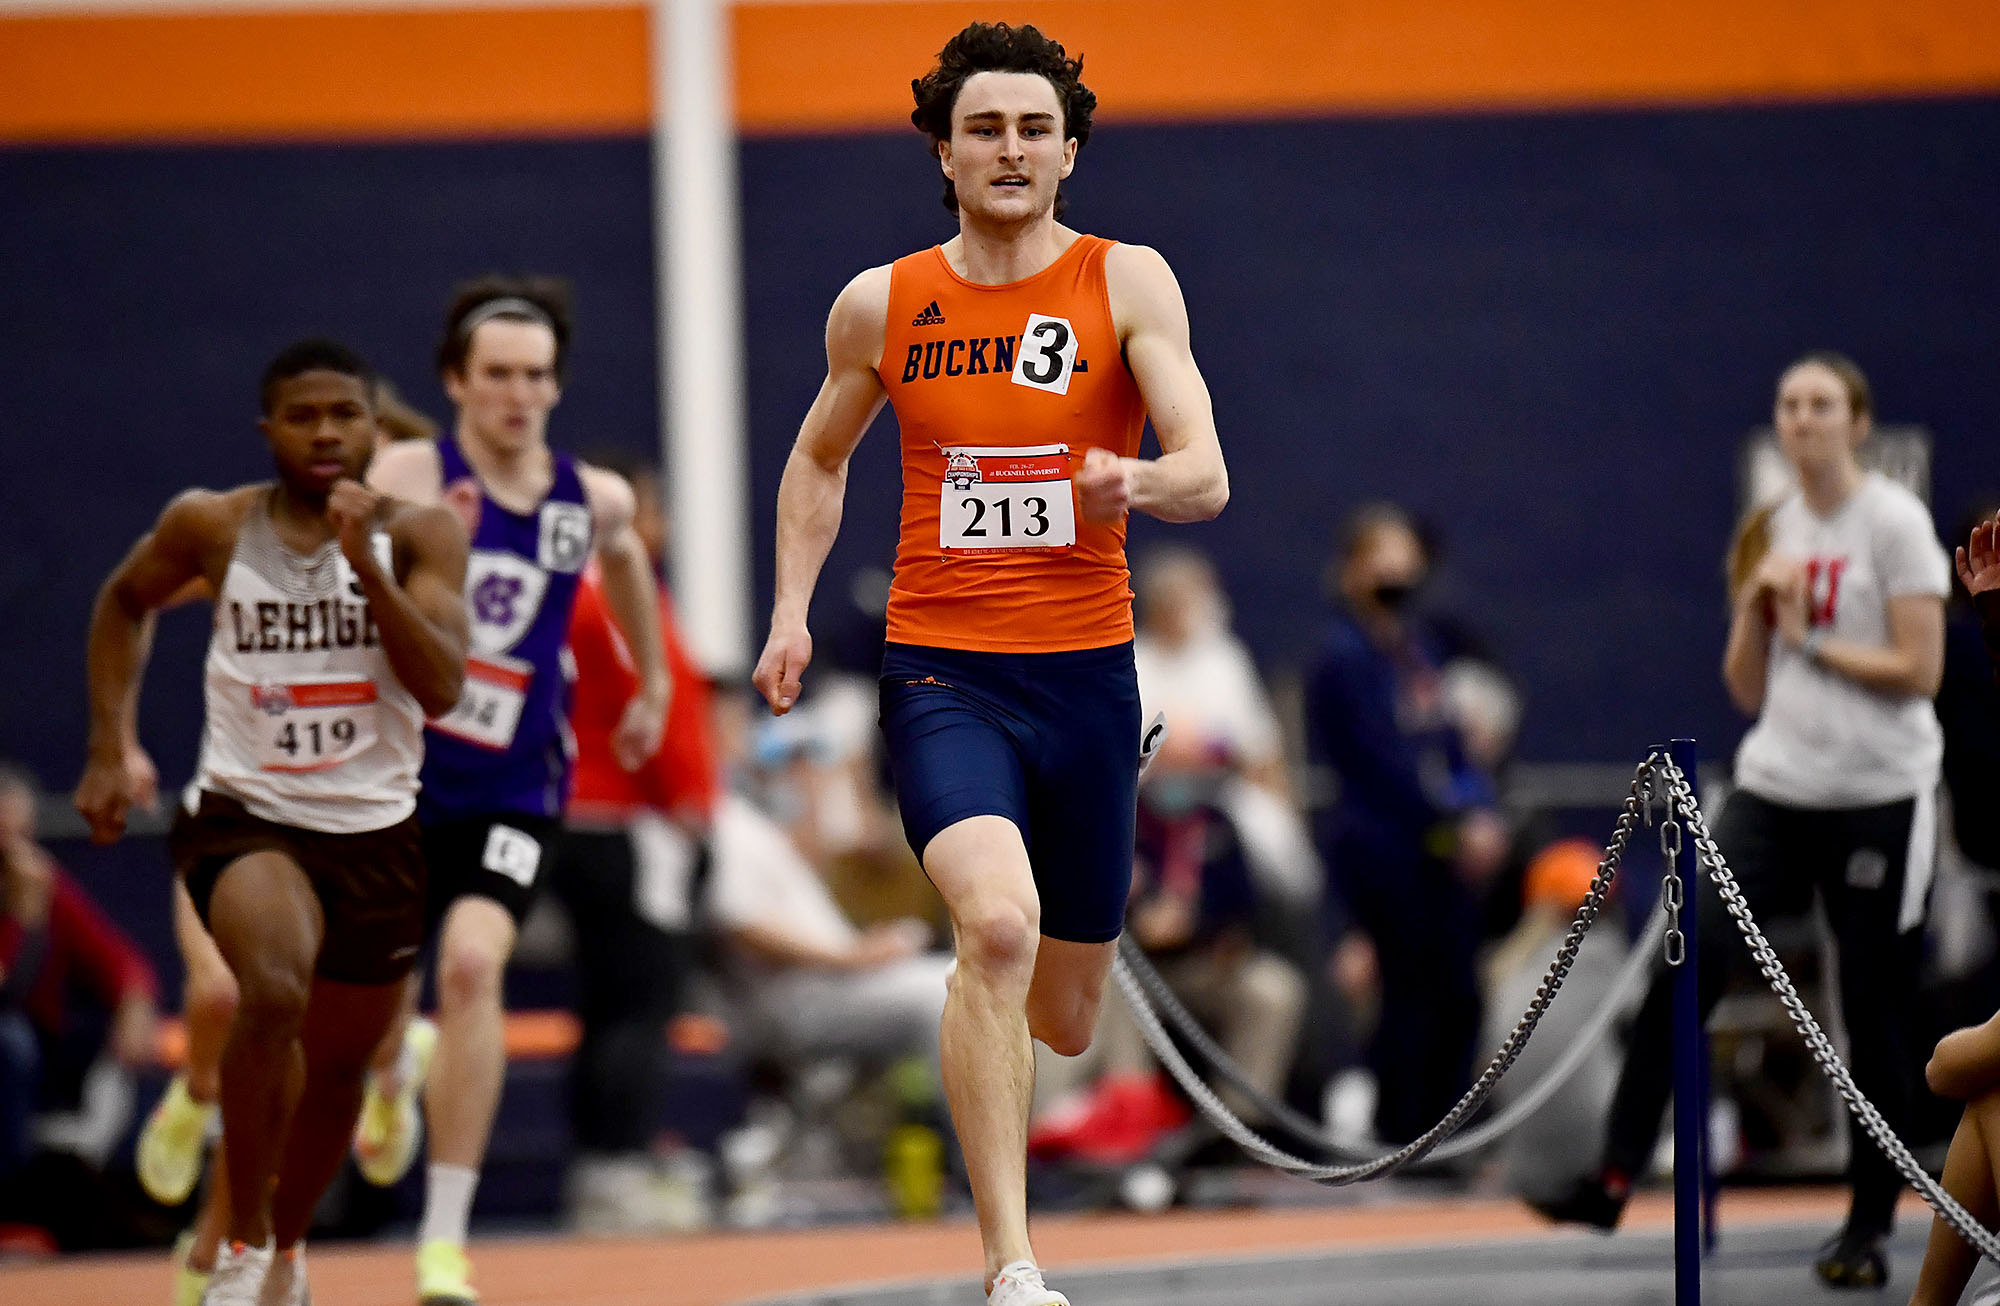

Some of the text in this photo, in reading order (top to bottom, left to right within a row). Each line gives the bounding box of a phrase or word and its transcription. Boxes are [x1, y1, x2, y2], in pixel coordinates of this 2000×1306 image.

[912, 316, 945, 326] adidas
[902, 334, 1089, 383] BUCKNL
[1022, 321, 1069, 384] 3
[1026, 467, 1060, 476] UNIVERSITY
[960, 497, 1050, 537] 213
[274, 717, 356, 756] 419
